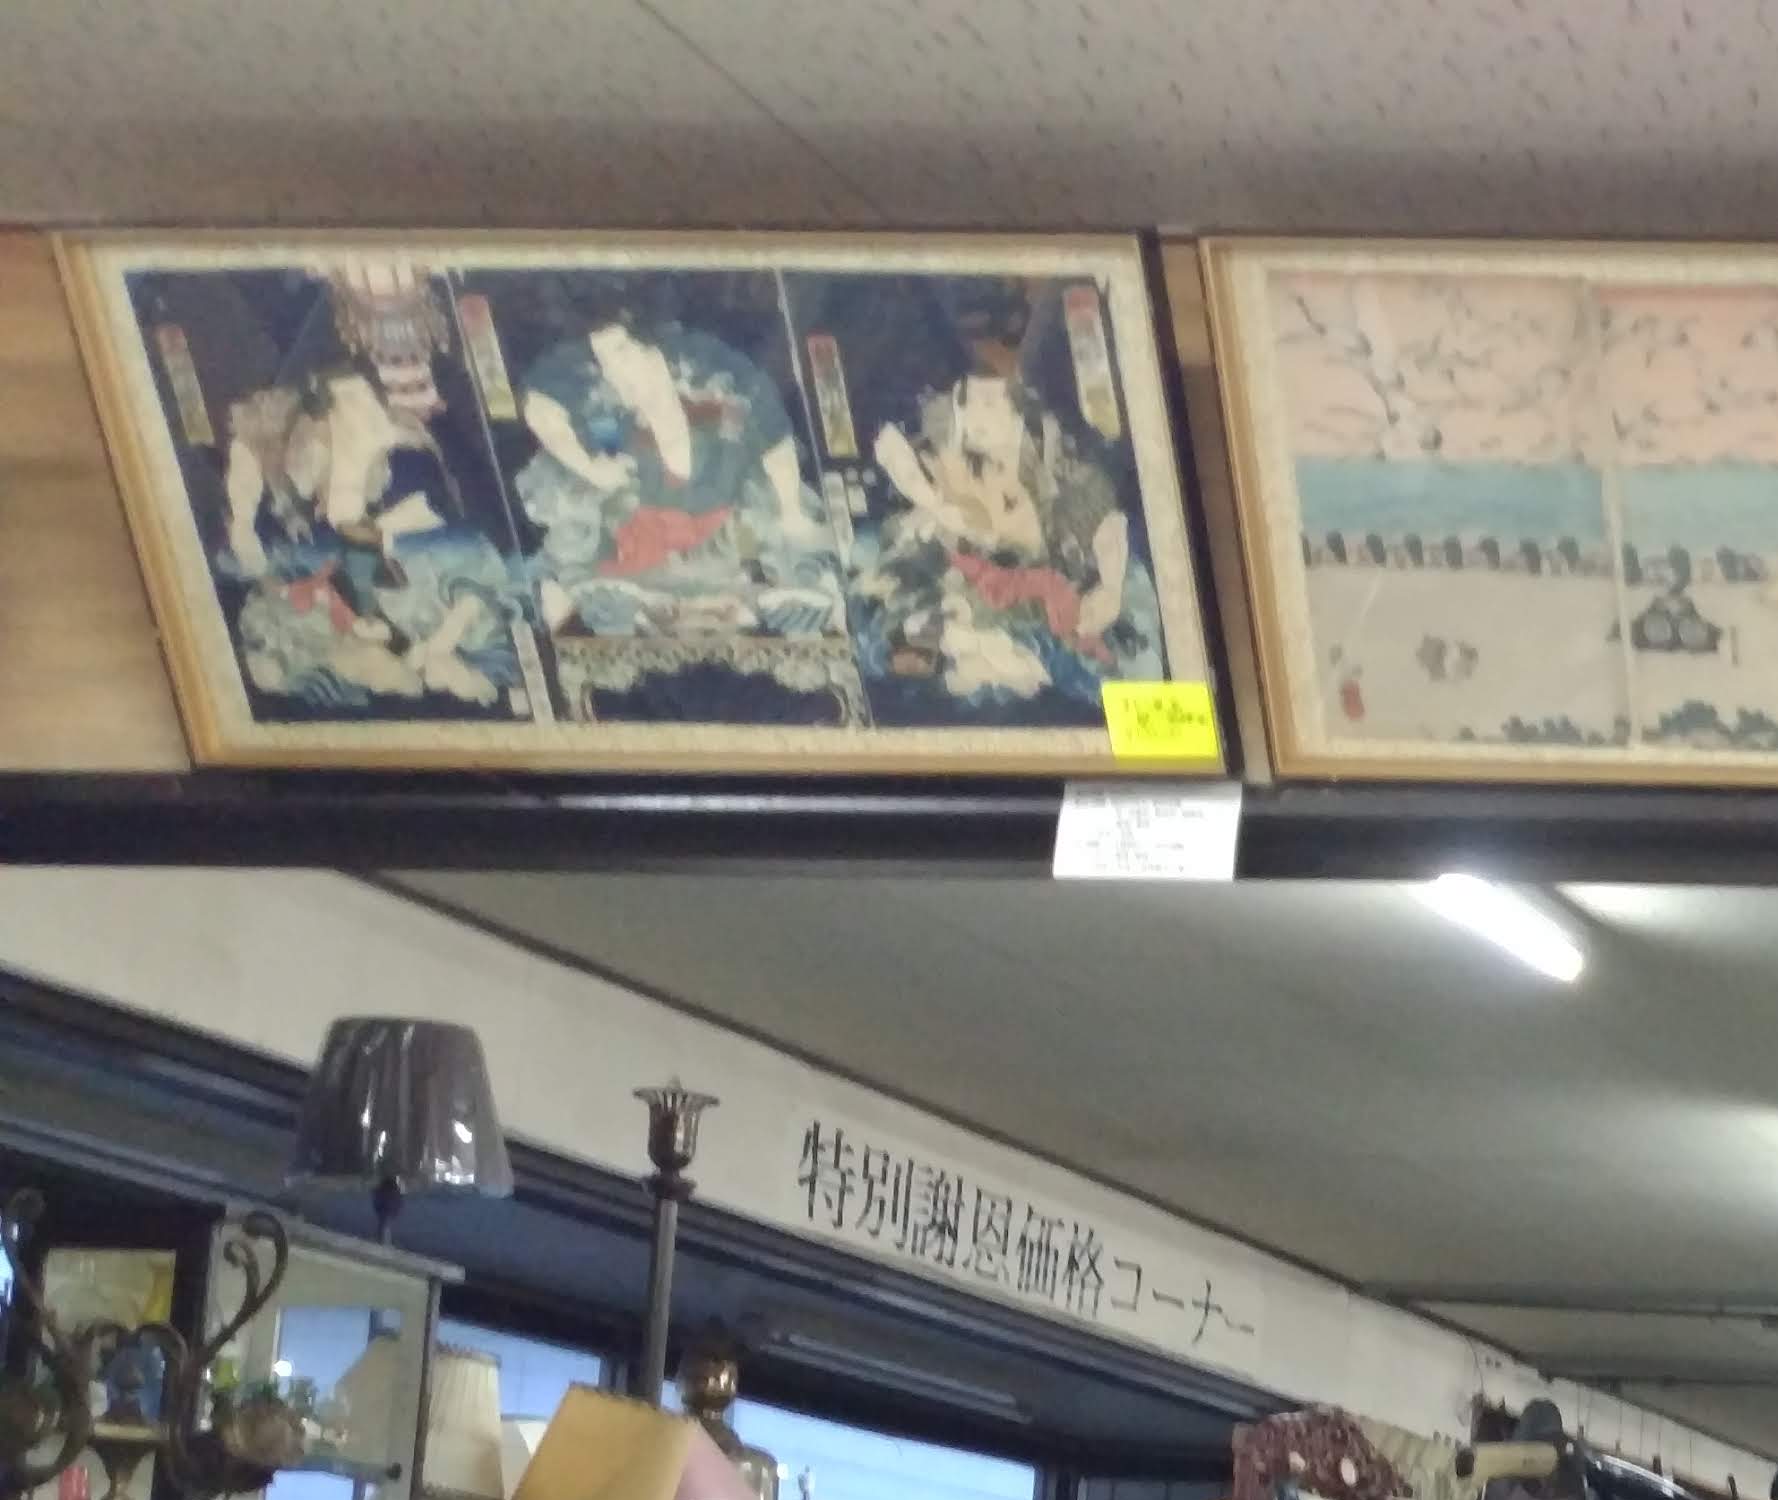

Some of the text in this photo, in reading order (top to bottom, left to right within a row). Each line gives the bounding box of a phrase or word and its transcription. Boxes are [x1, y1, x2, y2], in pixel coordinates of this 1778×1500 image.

[797, 1119, 1256, 1345] 特別謝恩価格コーナー
